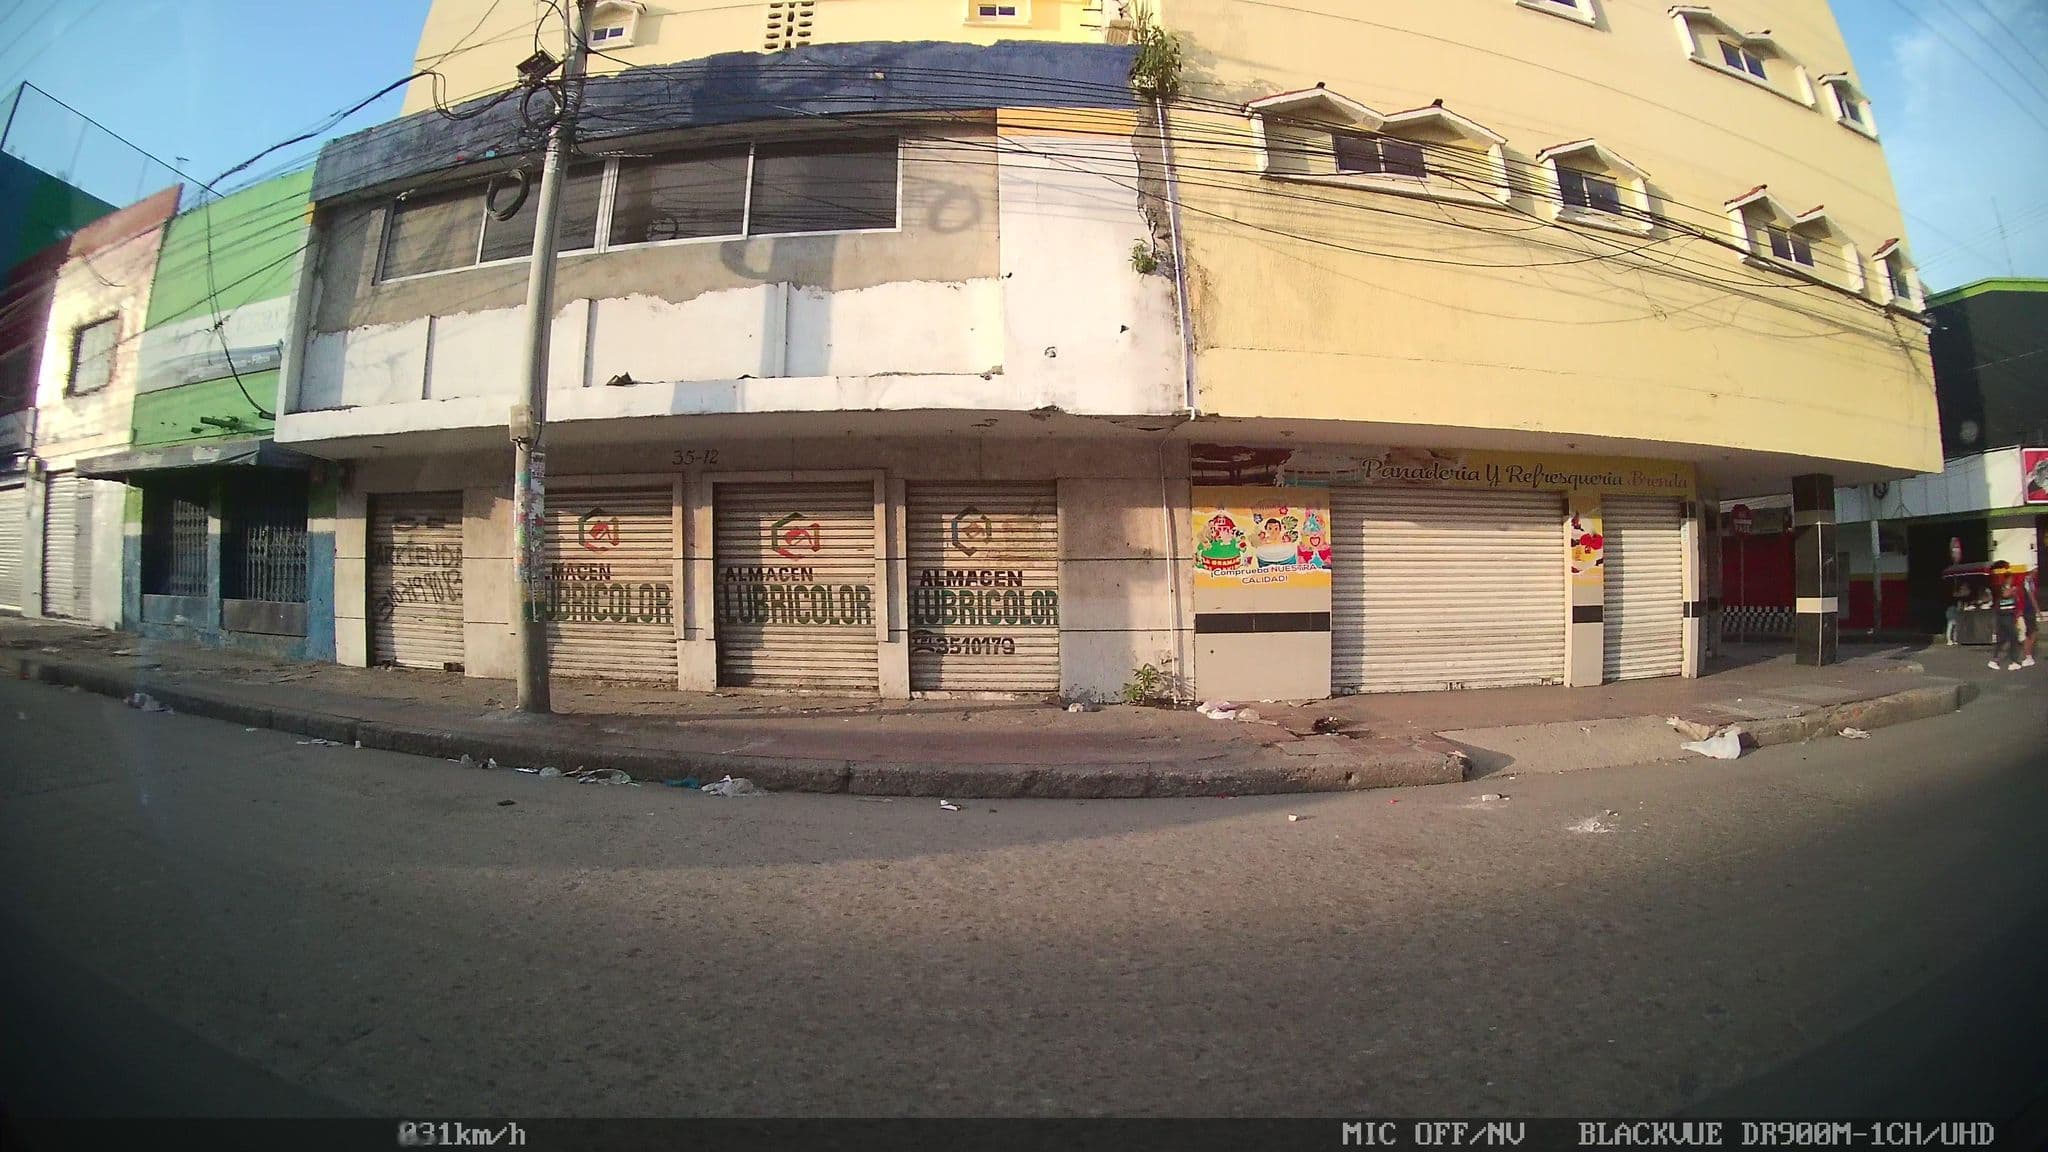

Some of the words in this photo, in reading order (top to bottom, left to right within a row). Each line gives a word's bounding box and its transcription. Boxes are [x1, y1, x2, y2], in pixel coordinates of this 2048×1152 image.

[672, 448, 719, 465] 35-12
[1361, 457, 1480, 482] Panaderia
[1486, 463, 1500, 488] Y
[1505, 463, 1623, 490] Refresqueria
[725, 567, 814, 582] ALMACEN
[542, 582, 671, 624] UBRICOLOR
[723, 584, 871, 625] LUBRICOLOR
[912, 589, 1058, 625] LUBRICOLOR
[936, 637, 1015, 655] 3510179
